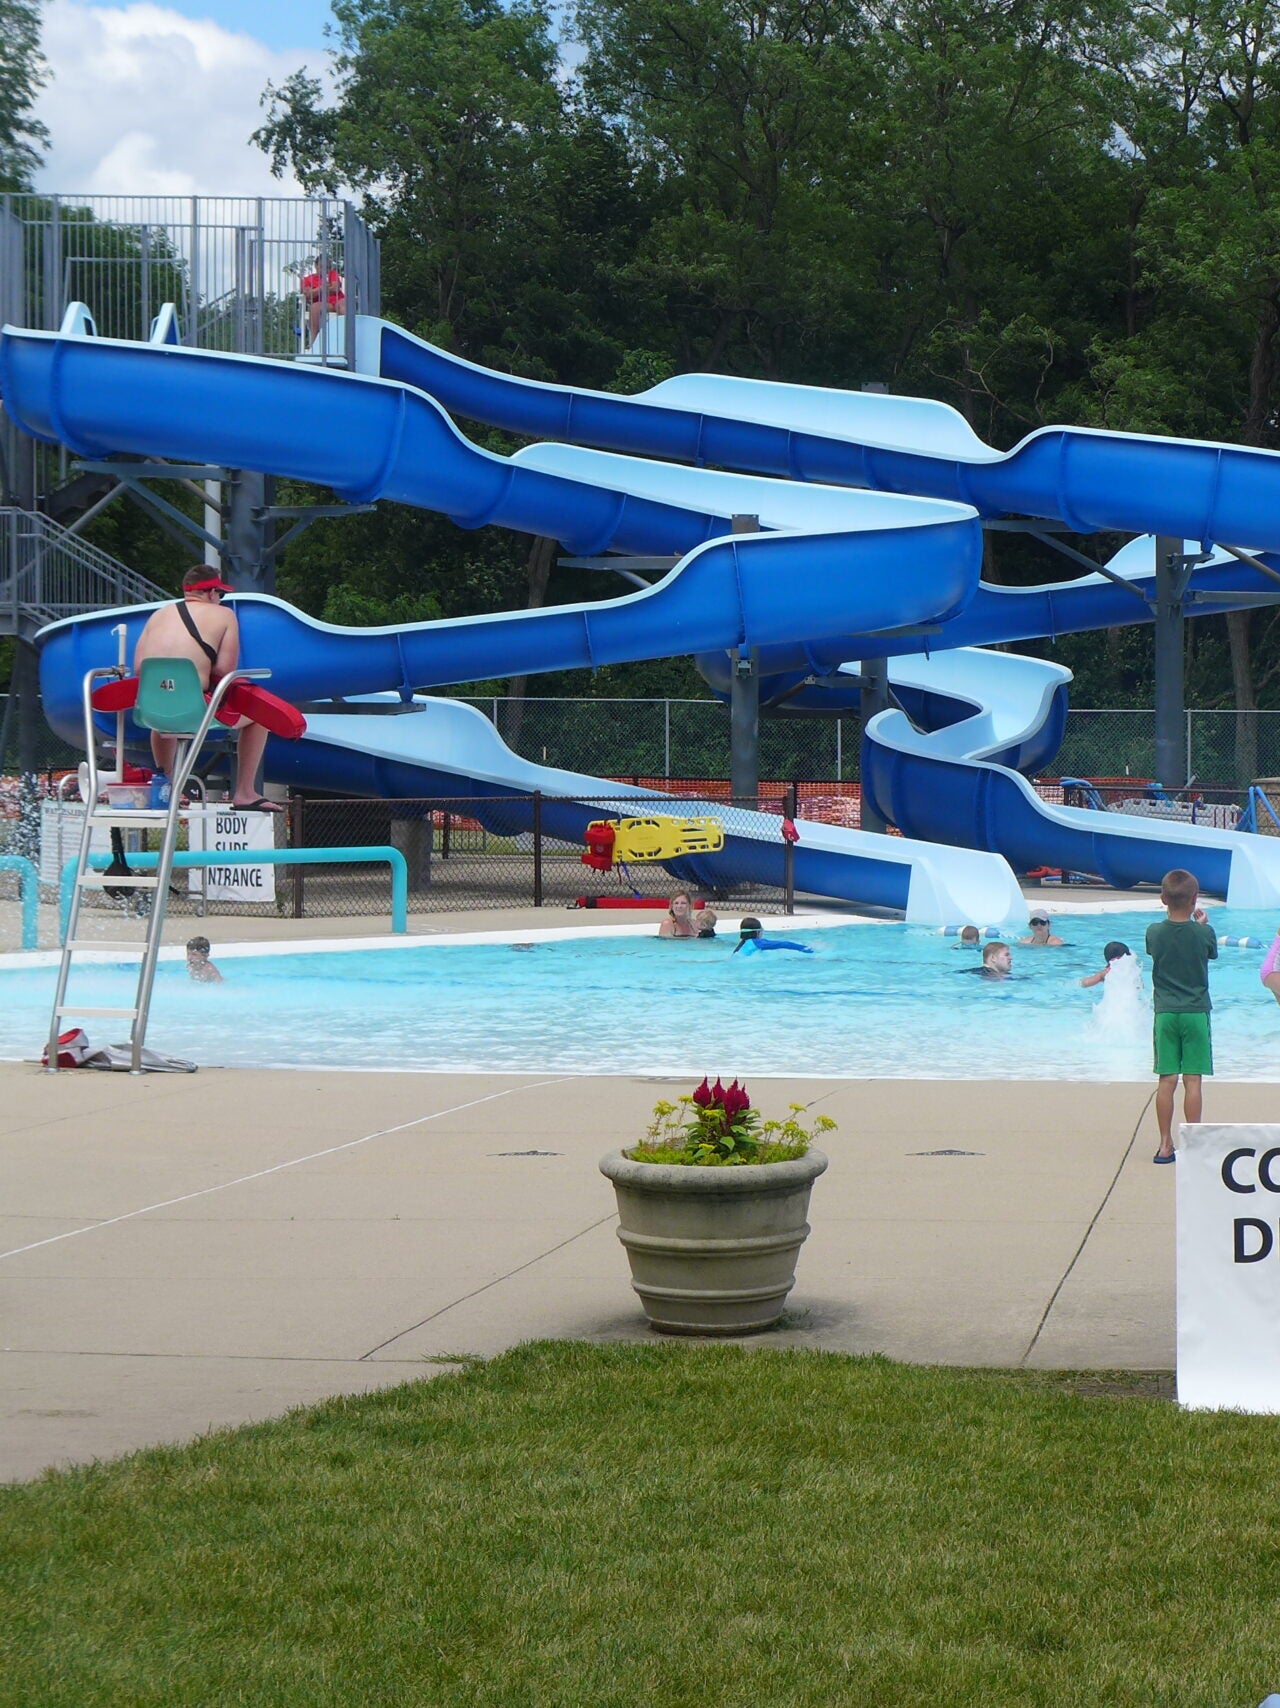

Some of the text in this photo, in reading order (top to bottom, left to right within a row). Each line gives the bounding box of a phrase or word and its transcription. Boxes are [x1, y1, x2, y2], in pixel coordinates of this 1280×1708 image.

[160, 679, 174, 691] 4A
[216, 817, 248, 834] BODY
[207, 866, 263, 887] NTRANCE
